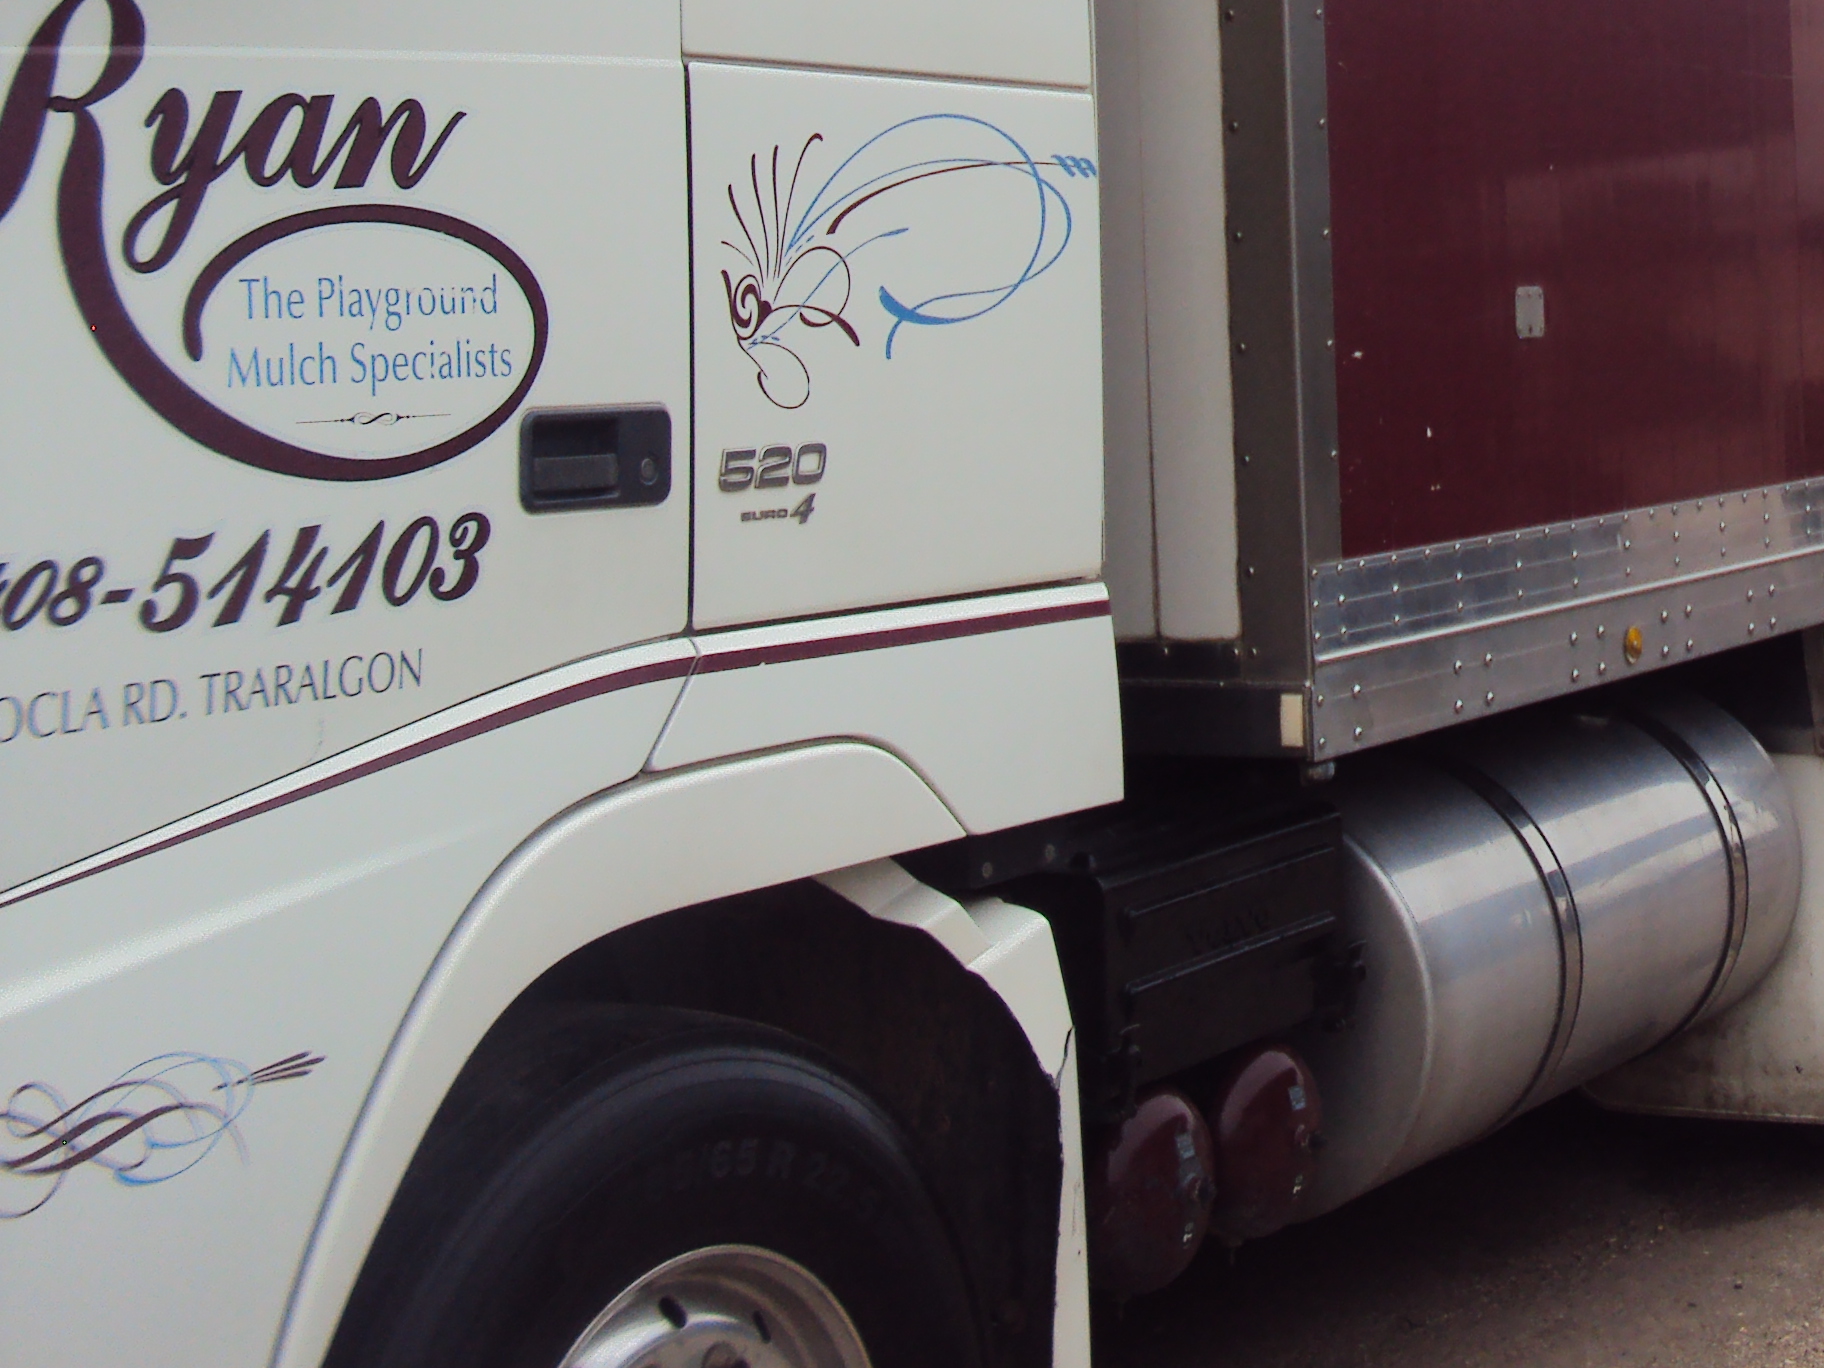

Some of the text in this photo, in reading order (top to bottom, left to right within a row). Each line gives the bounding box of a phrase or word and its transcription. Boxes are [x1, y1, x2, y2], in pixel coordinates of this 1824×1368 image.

[239, 273, 499, 333] The Playground
[226, 339, 513, 397] Mulch Specialists
[719, 440, 827, 492] 520
[0, 511, 492, 633] 08-514103
[122, 678, 188, 727] RD.
[199, 647, 425, 717] TRARALGON
